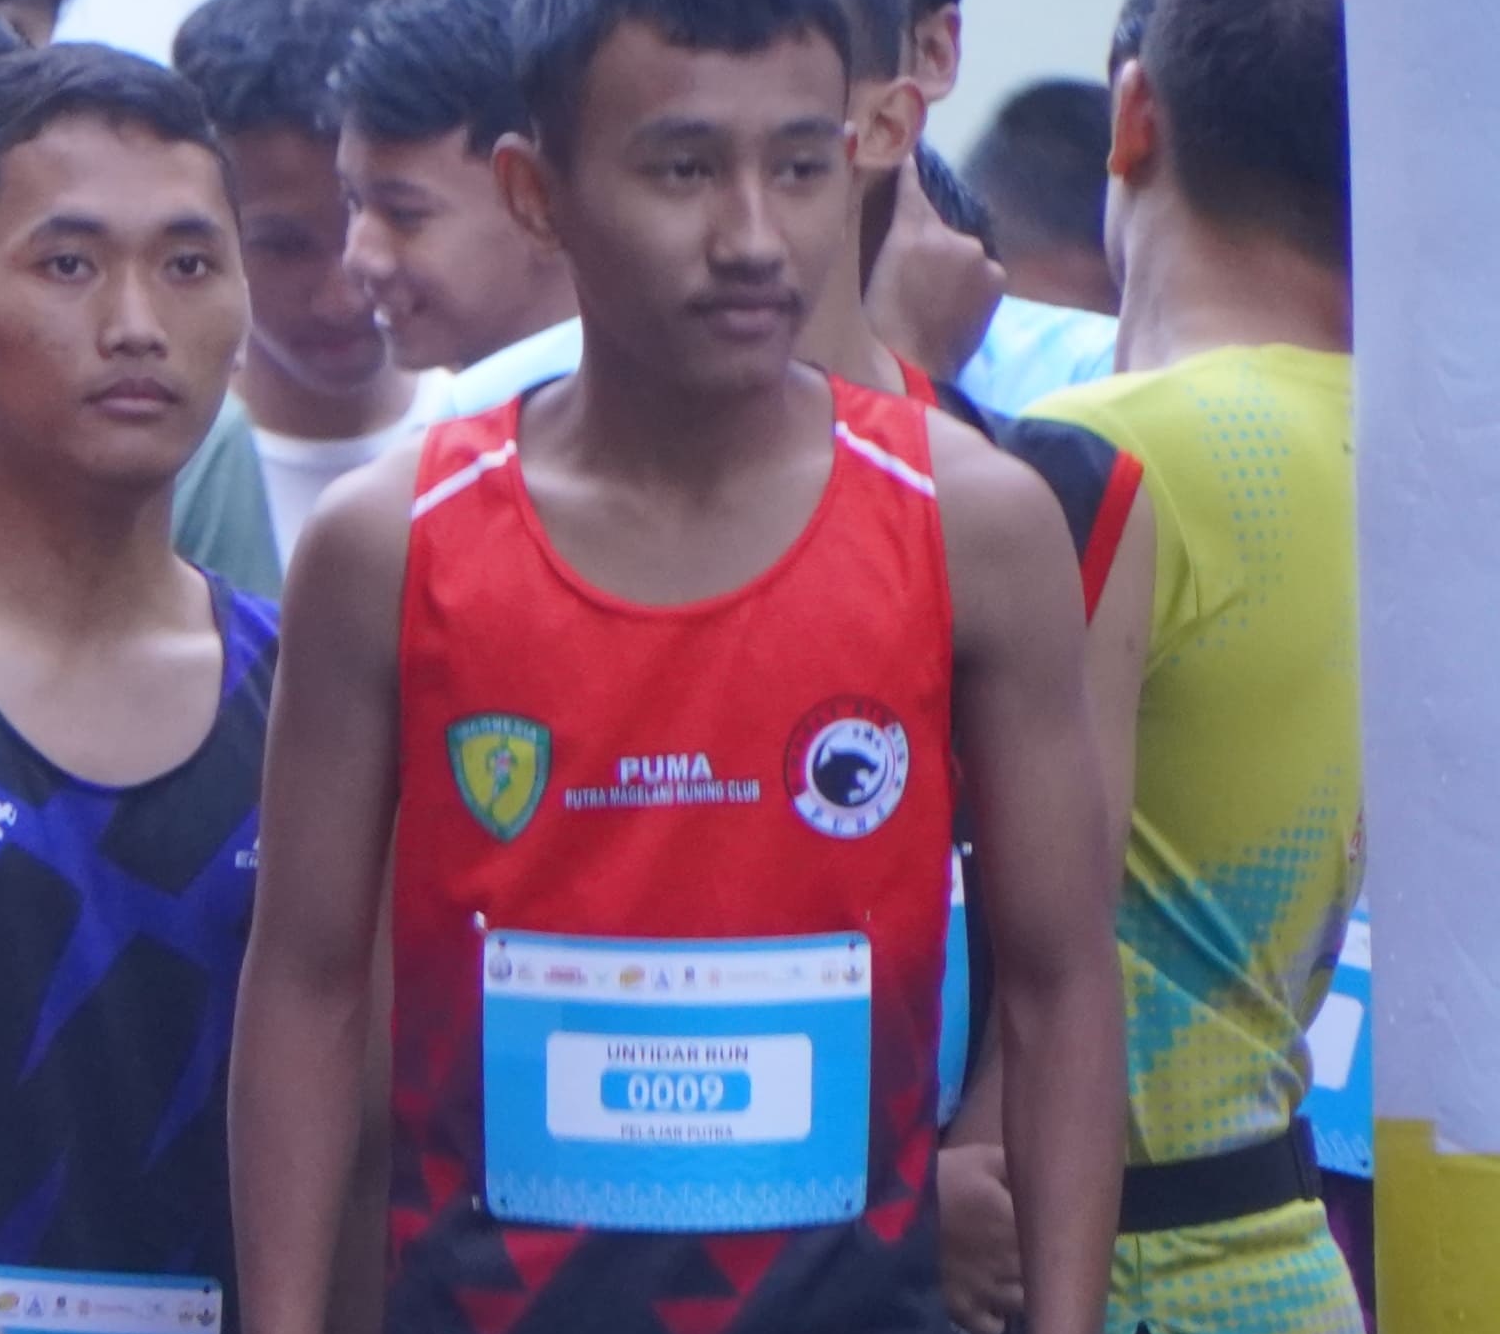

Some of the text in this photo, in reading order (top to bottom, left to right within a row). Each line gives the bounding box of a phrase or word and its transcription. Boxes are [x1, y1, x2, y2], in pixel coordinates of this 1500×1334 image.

[618, 752, 714, 784] PUMA
[728, 778, 761, 803] CLUB
[606, 1043, 749, 1064] UNTIDAR RUN
[627, 1073, 724, 1111] 0009
